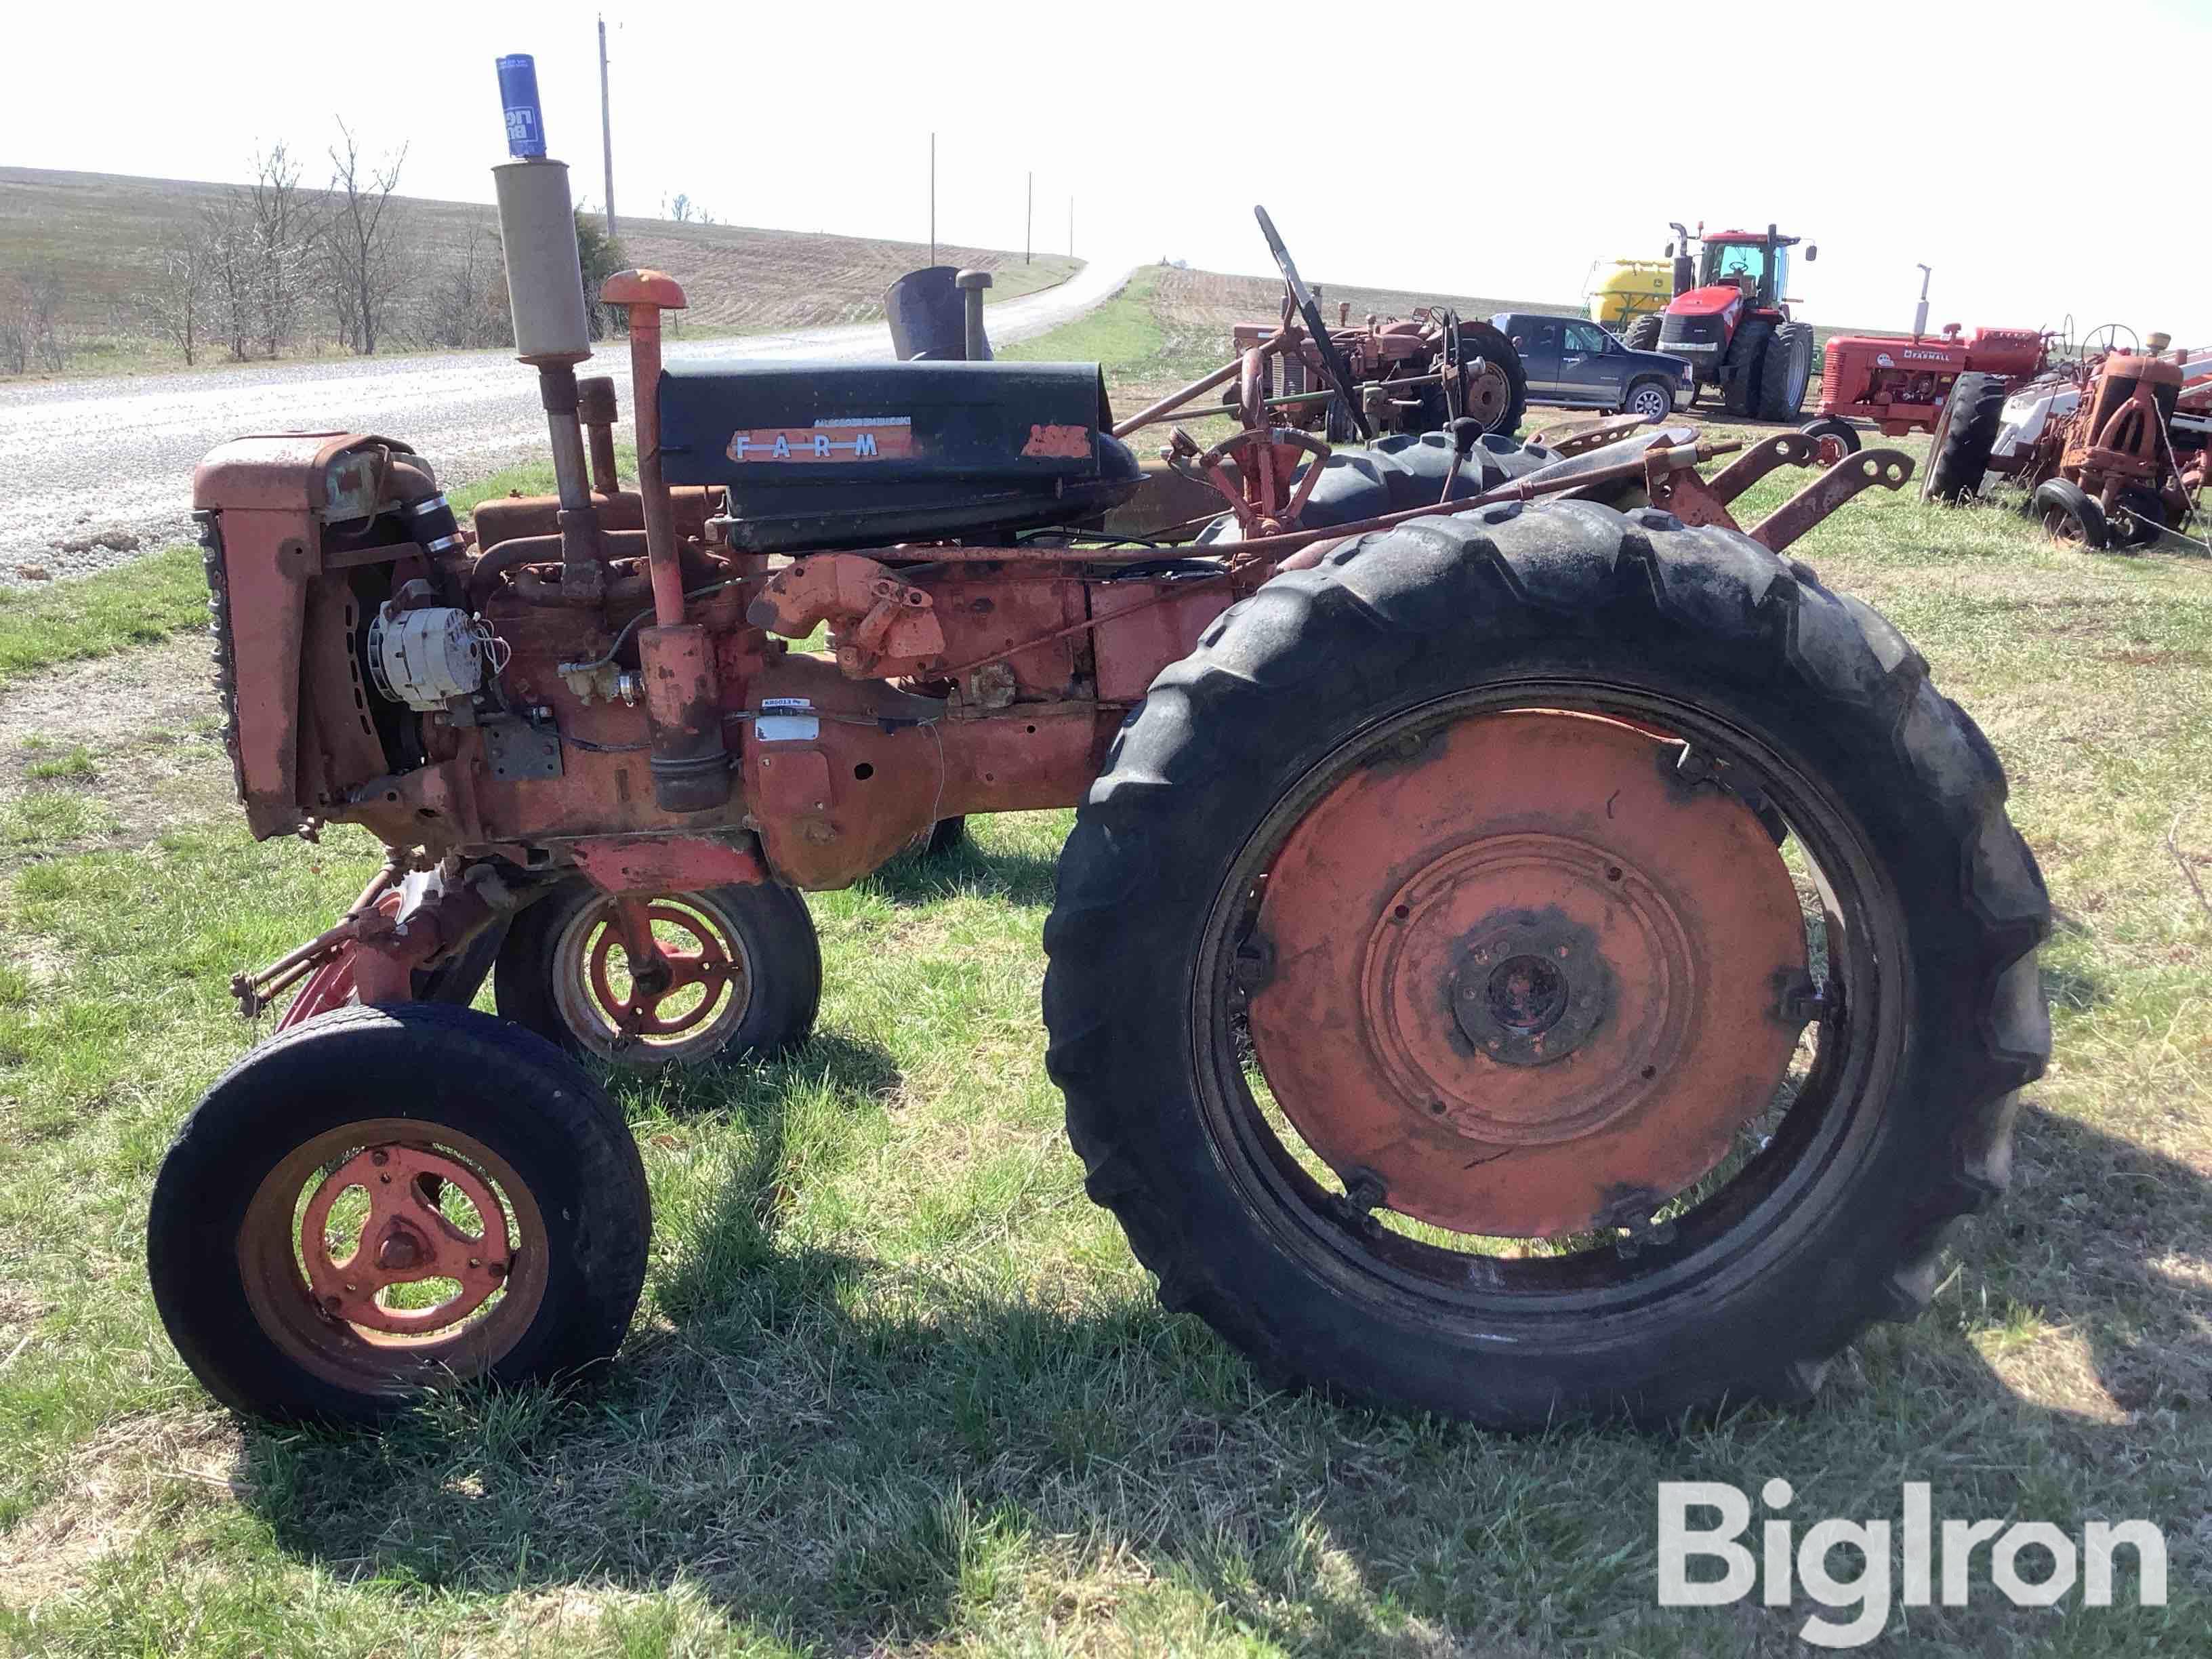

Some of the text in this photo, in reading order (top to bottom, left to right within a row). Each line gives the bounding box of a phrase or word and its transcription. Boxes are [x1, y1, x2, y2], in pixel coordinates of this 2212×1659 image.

[506, 110, 532, 126] LIG
[506, 125, 527, 140] BU
[737, 433, 878, 459] FARM
